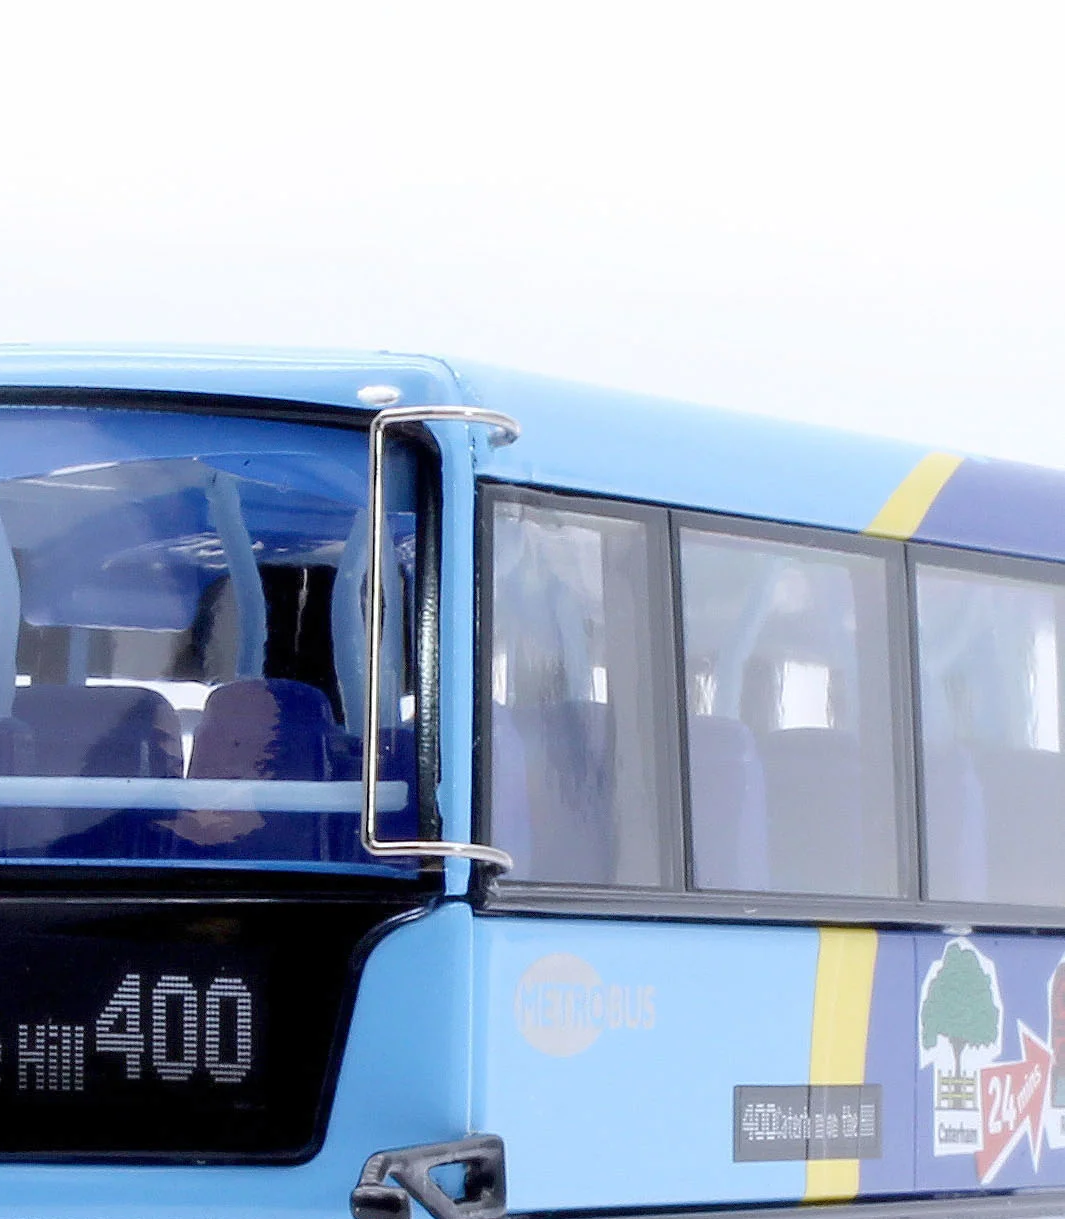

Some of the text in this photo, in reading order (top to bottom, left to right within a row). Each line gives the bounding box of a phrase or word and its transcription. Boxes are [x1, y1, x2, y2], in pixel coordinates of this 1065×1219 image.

[95, 973, 252, 1083] 400
[519, 978, 656, 1029] METROBUS
[18, 1024, 85, 1090] Hill
[988, 1074, 1017, 1134] 24
